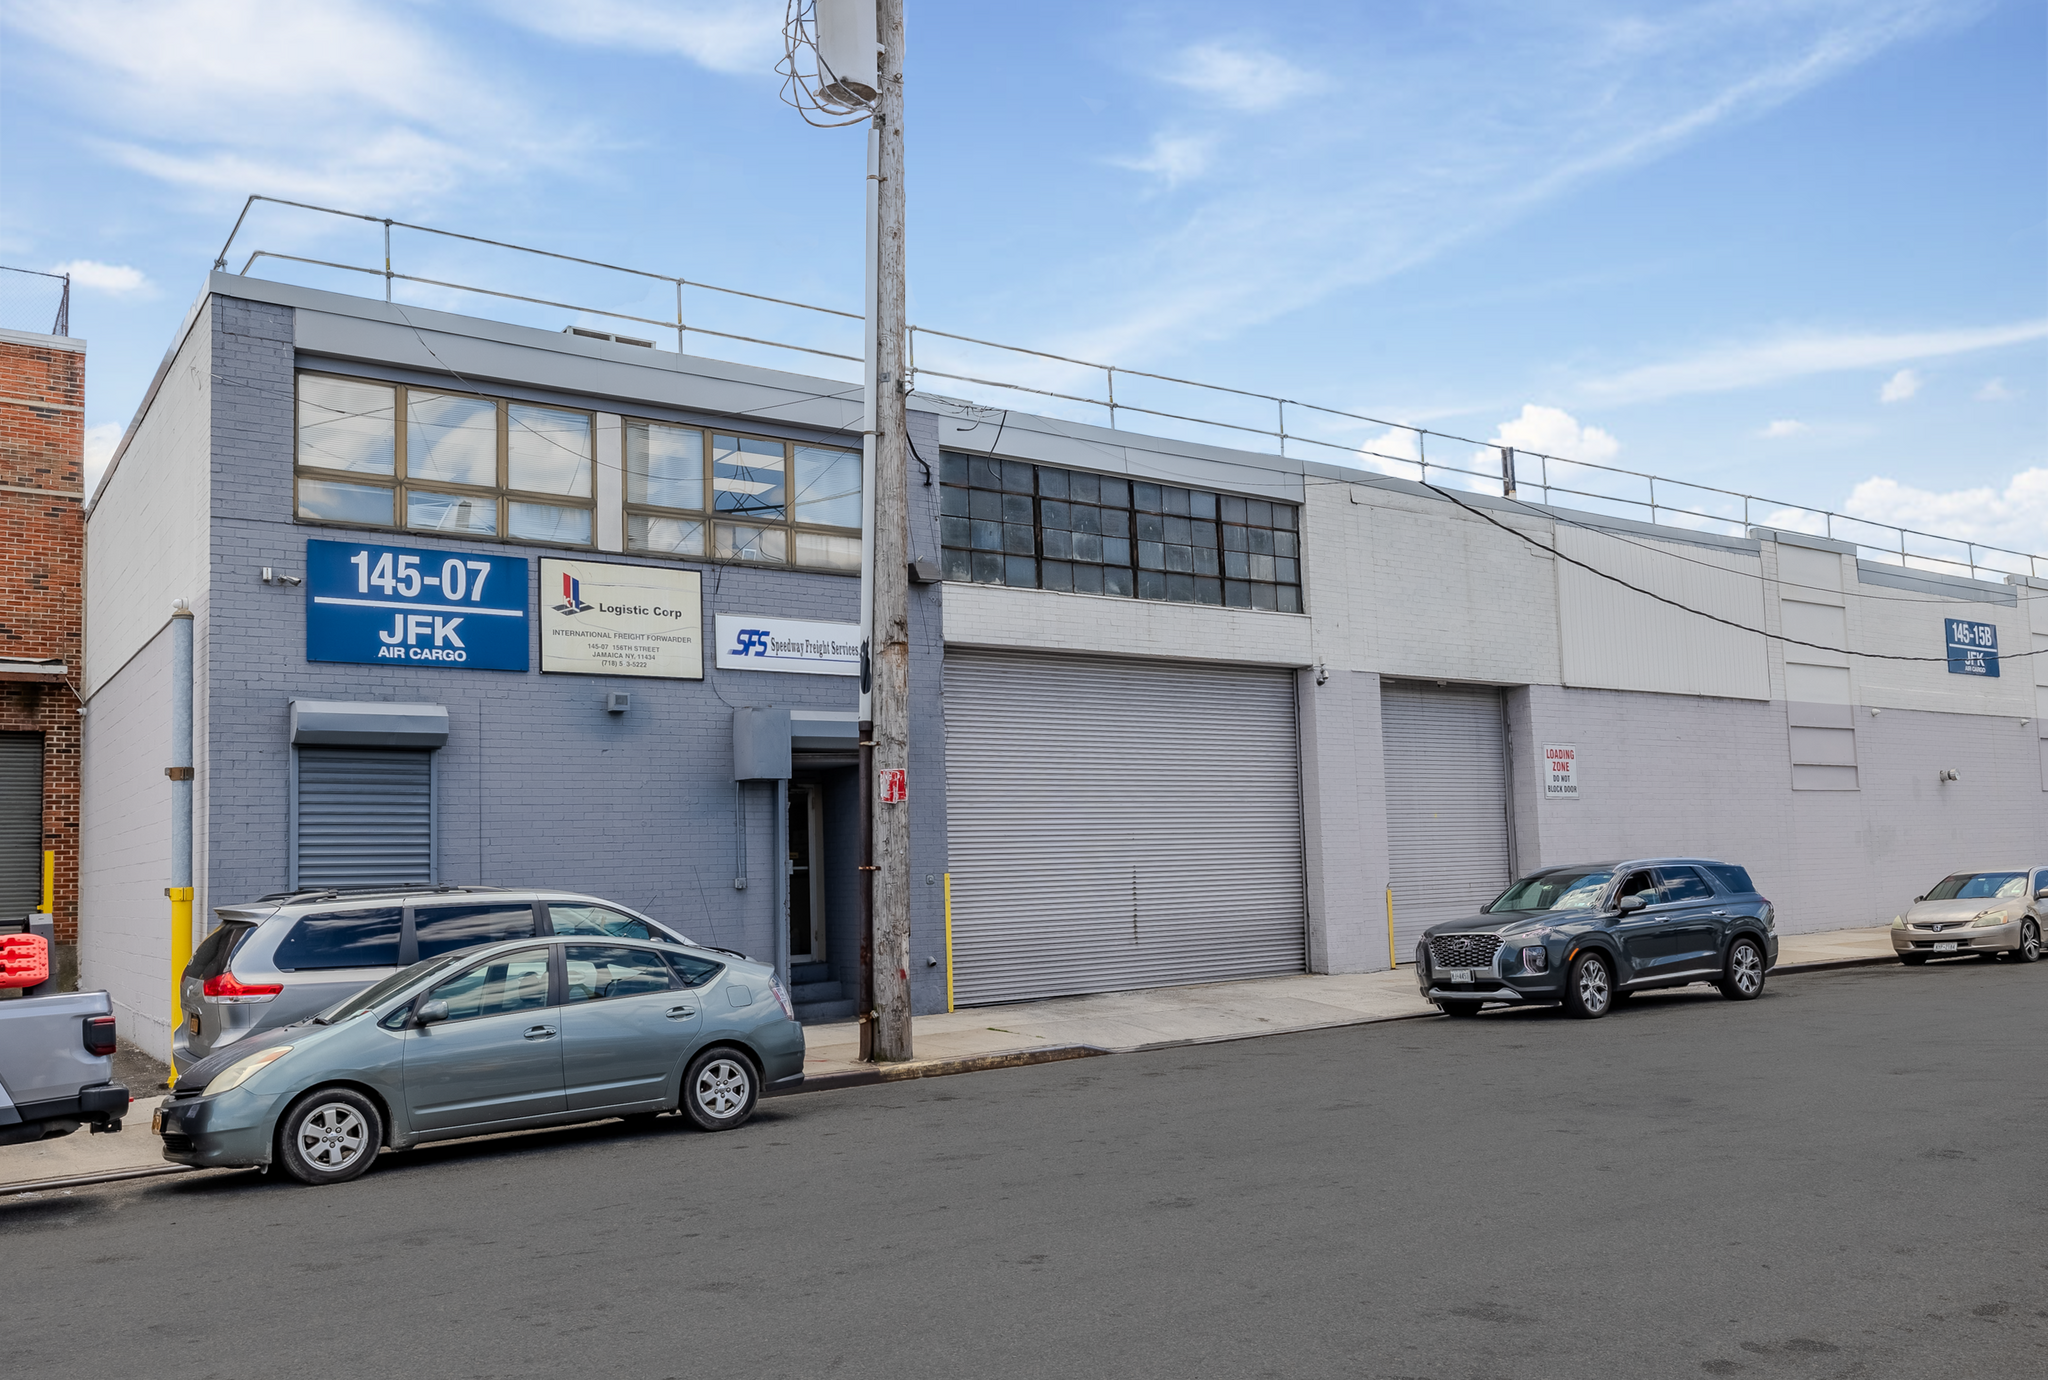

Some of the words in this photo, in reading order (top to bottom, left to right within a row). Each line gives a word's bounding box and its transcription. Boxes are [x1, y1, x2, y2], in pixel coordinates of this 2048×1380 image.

[350, 550, 491, 602] 145-07
[599, 602, 650, 616] Logistic
[653, 606, 682, 620] Corp
[378, 613, 466, 648] JFK
[552, 629, 612, 639] INTERNATIONAL
[613, 632, 645, 641] FREIGHT
[647, 634, 692, 644] FORWARDER
[1952, 622, 1992, 646] 145-15B
[633, 645, 660, 653] STREET
[729, 628, 771, 657] SFS
[770, 636, 804, 657] Speedway
[805, 638, 831, 658] Freight
[831, 640, 859, 656] Services
[377, 646, 406, 659] AIR
[409, 647, 467, 662] CARGO
[592, 651, 623, 659] JAMAICA
[1964, 651, 1985, 666] JFK
[601, 659, 618, 667] (718)
[1546, 748, 1575, 760] LOADING
[1552, 761, 1570, 772] ZONE
[1561, 774, 1570, 782] NOT
